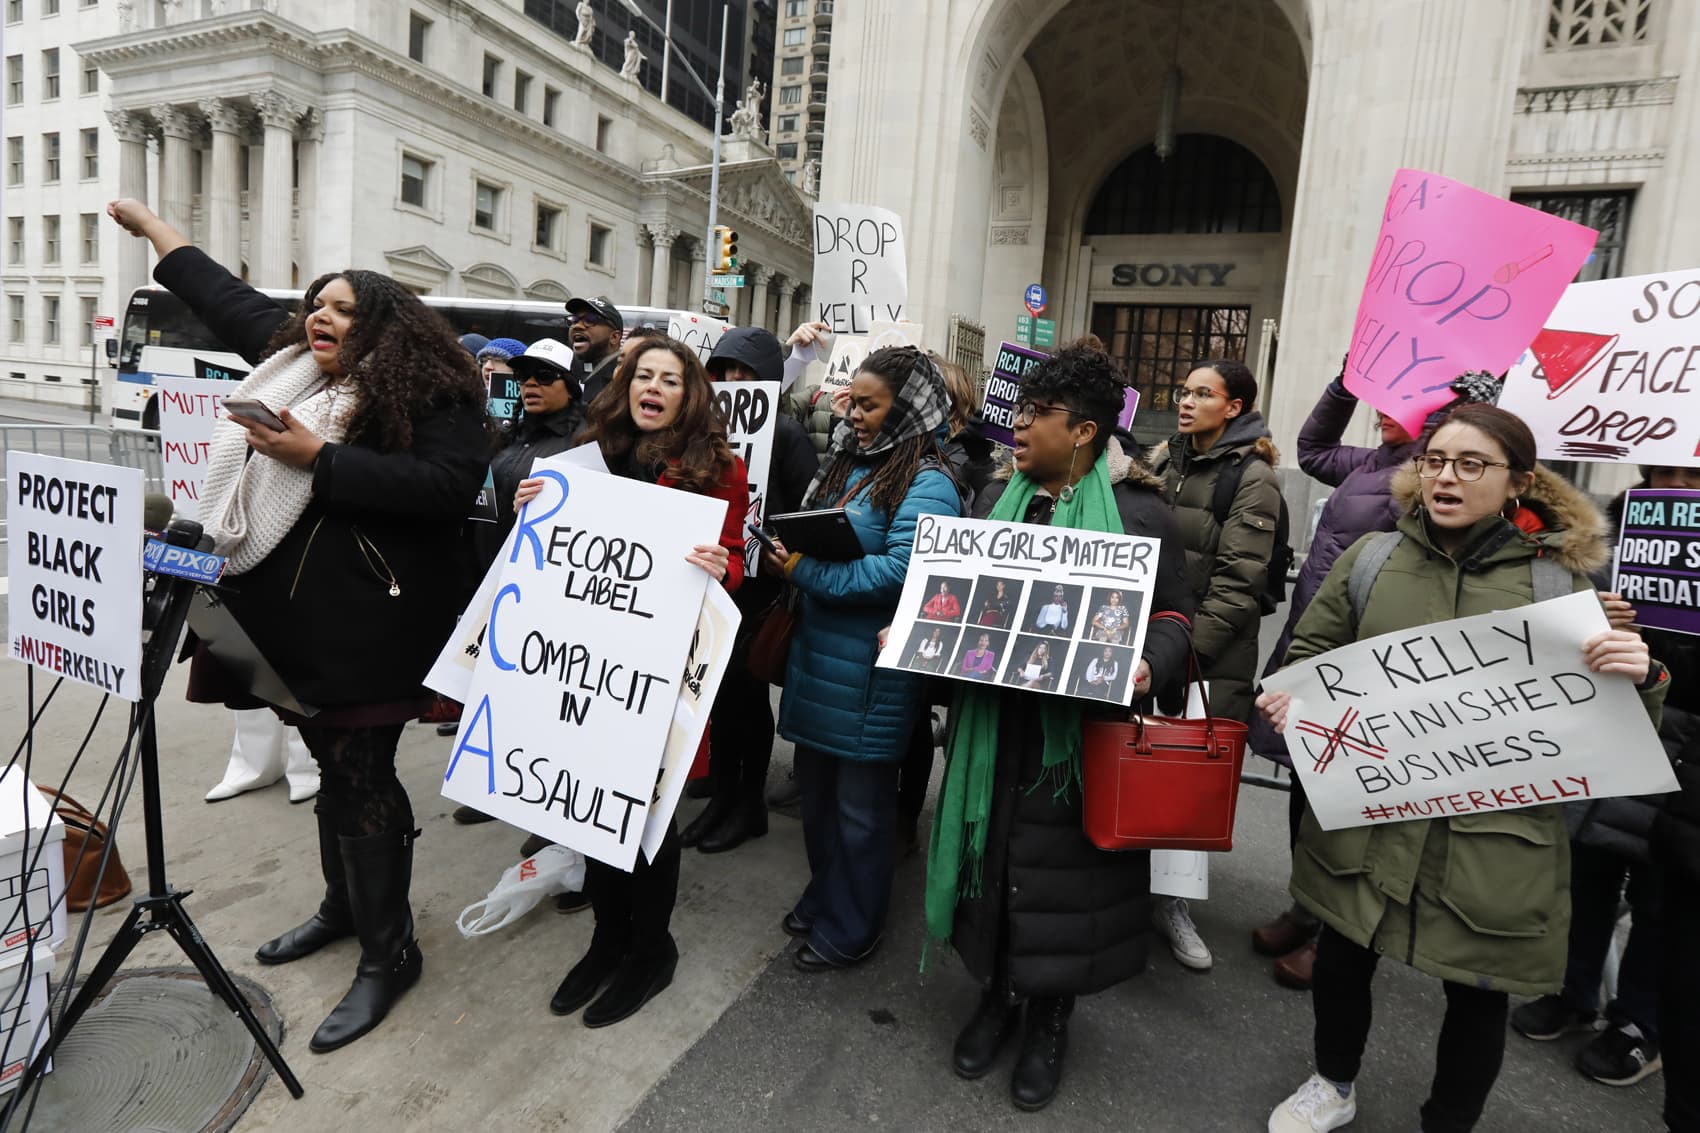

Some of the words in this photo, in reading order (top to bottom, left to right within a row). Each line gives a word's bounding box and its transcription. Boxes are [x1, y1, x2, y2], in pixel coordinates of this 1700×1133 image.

[816, 214, 898, 256] DROP
[850, 258, 869, 295] R
[1112, 262, 1236, 288] SONY
[1367, 234, 1511, 325] DROP
[997, 352, 1021, 375] RCA
[1558, 405, 1677, 446] DROP
[18, 471, 118, 524] PROTECT
[1627, 501, 1666, 526] RCA
[28, 530, 103, 584] BLACK
[163, 548, 204, 571] PIX
[914, 515, 987, 557] BLACK
[988, 527, 1058, 563] GIRLS
[1060, 535, 1153, 575] MATTER
[1621, 538, 1681, 566] DROP
[31, 583, 96, 636] GIRLS
[565, 569, 654, 618] LABEL
[13, 635, 125, 695] #MUTERKELLY
[1315, 662, 1368, 702] R.
[1372, 619, 1536, 689] KELLY
[560, 693, 591, 726] IN
[1355, 729, 1562, 795] BUSINESS
[1361, 775, 1593, 821] #MUTERKELLY
